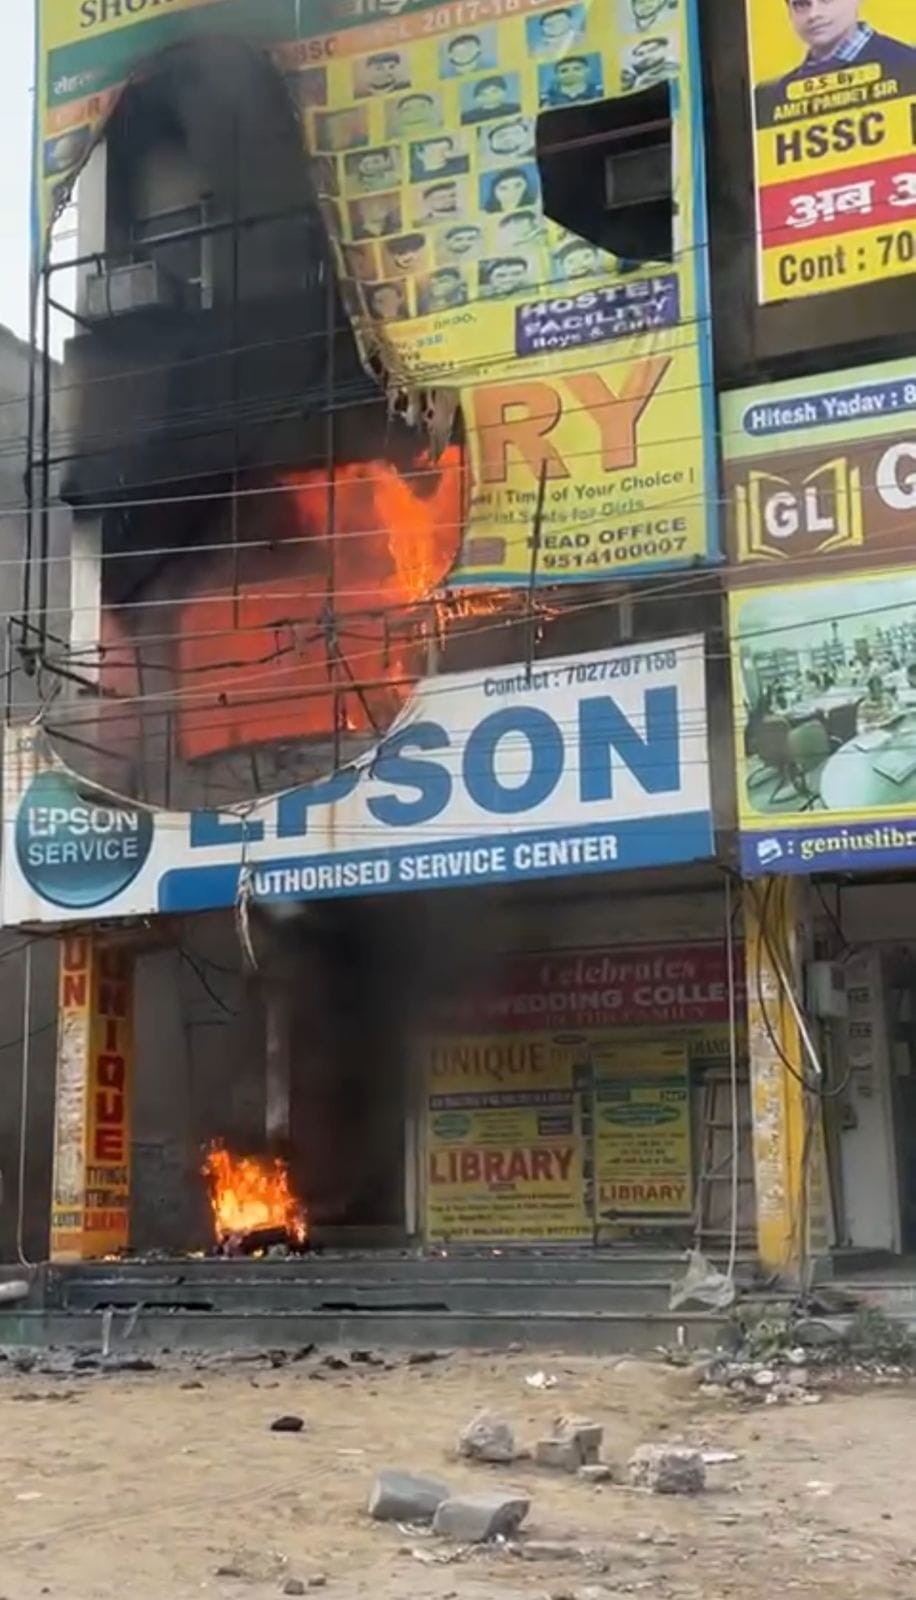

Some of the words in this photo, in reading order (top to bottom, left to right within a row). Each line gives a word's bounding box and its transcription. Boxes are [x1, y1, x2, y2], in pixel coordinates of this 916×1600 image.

[773, 96, 809, 121] AMIT
[872, 79, 898, 99] SIR
[776, 112, 885, 165] HSSC
[786, 180, 875, 229] अब
[779, 245, 845, 286] Cont
[521, 278, 675, 317] HOSTEL
[523, 296, 669, 336] FACILITY
[533, 331, 582, 350] Boys
[591, 327, 604, 340] &
[752, 402, 817, 430] Hitesh
[823, 394, 885, 420] Yadav
[551, 489, 568, 502] of
[574, 482, 616, 499] Your
[620, 470, 684, 491] Choice
[602, 499, 645, 517] Girls
[764, 486, 834, 538] GL
[598, 517, 688, 542] OFFICE
[484, 671, 549, 697] Contact
[28, 808, 139, 837] EPSON
[28, 839, 139, 867] SERVICE
[399, 847, 506, 880] SERVICE
[514, 834, 618, 869] CENTER
[431, 1042, 546, 1082] UNIQUE
[429, 1148, 574, 1184] LIBRARY
[599, 1184, 687, 1202] LIBRARY
